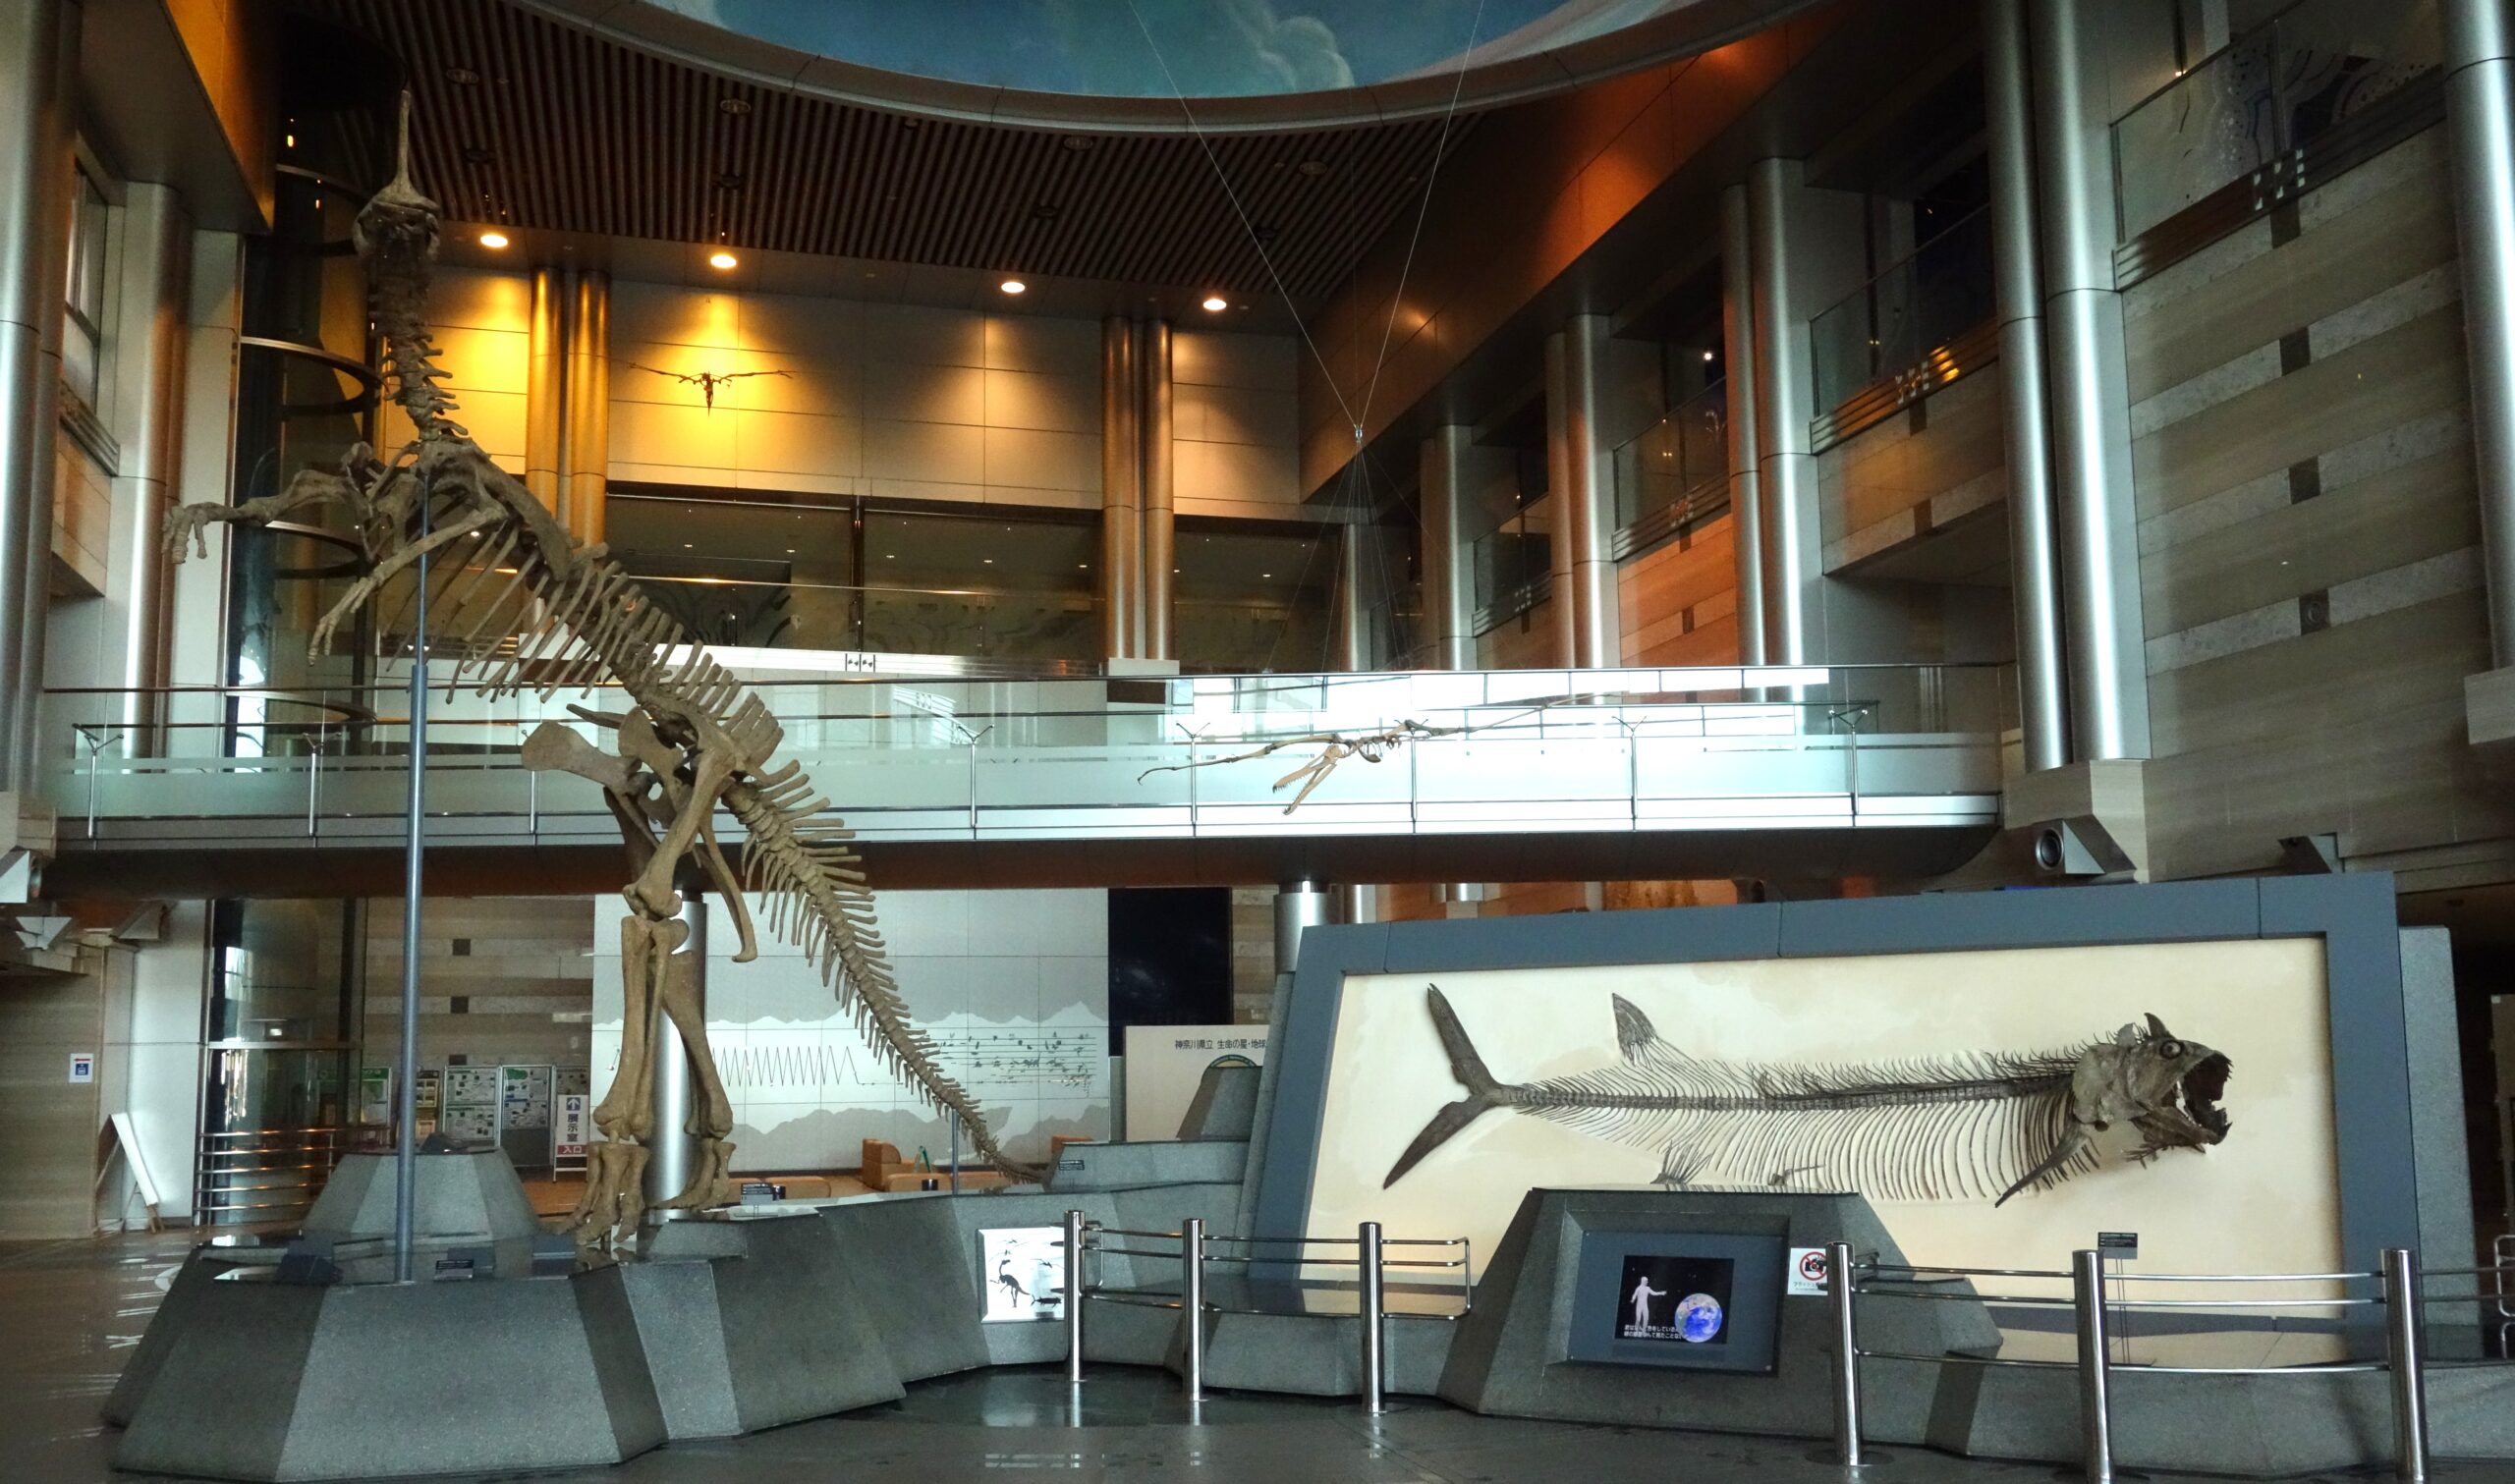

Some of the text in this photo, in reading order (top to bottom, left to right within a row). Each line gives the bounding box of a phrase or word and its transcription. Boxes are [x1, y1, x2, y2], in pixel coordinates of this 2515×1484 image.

[567, 1114, 579, 1141] 展示室
[563, 1145, 583, 1154] 入口
